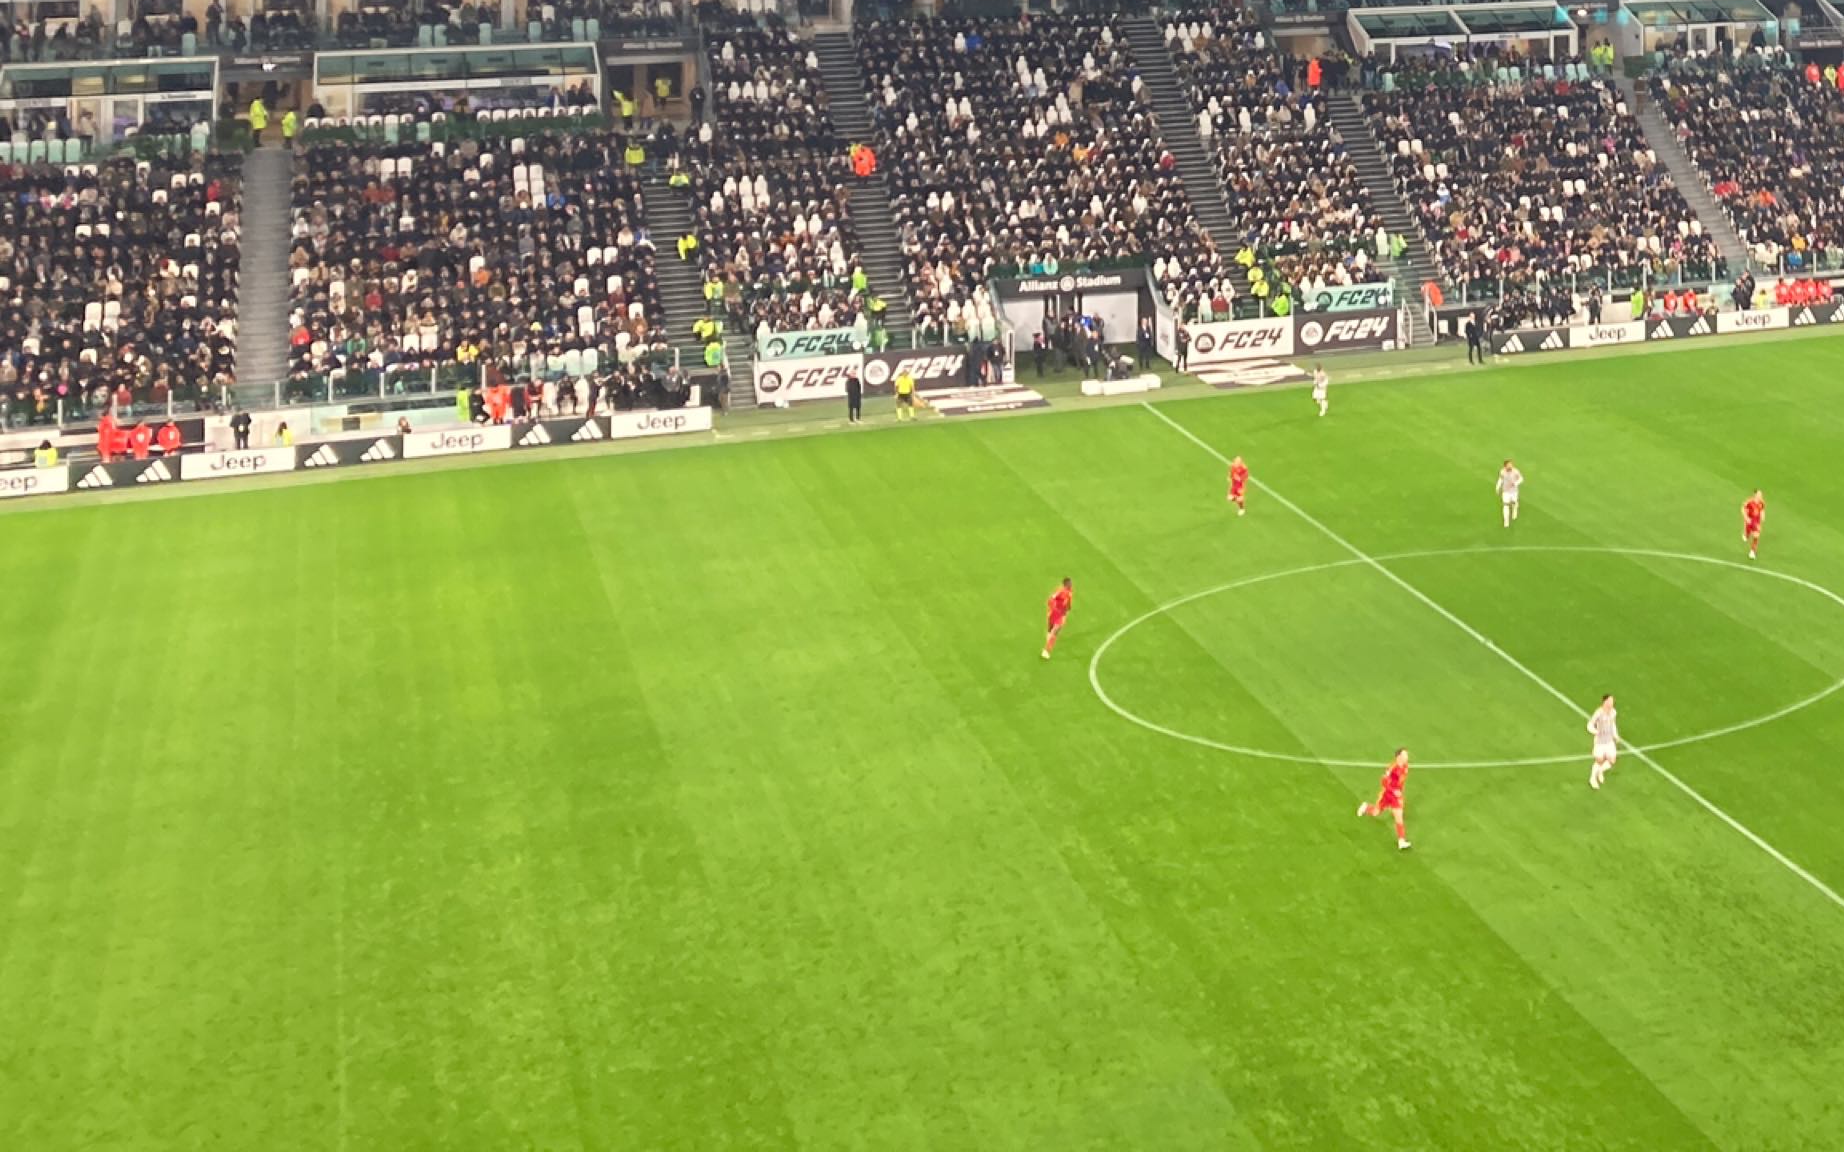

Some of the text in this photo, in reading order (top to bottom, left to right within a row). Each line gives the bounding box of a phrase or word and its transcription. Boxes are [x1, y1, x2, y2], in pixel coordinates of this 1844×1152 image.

[1018, 275, 1121, 292] Allianz Stadium
[1735, 312, 1772, 327] Jeep
[1324, 316, 1389, 342] FC24
[1588, 326, 1627, 342] Jeep
[1219, 327, 1284, 352] FC24
[891, 354, 966, 381] FC24
[636, 414, 687, 431] Jeep
[431, 432, 484, 449] Jeep
[210, 453, 267, 471] Jeep
